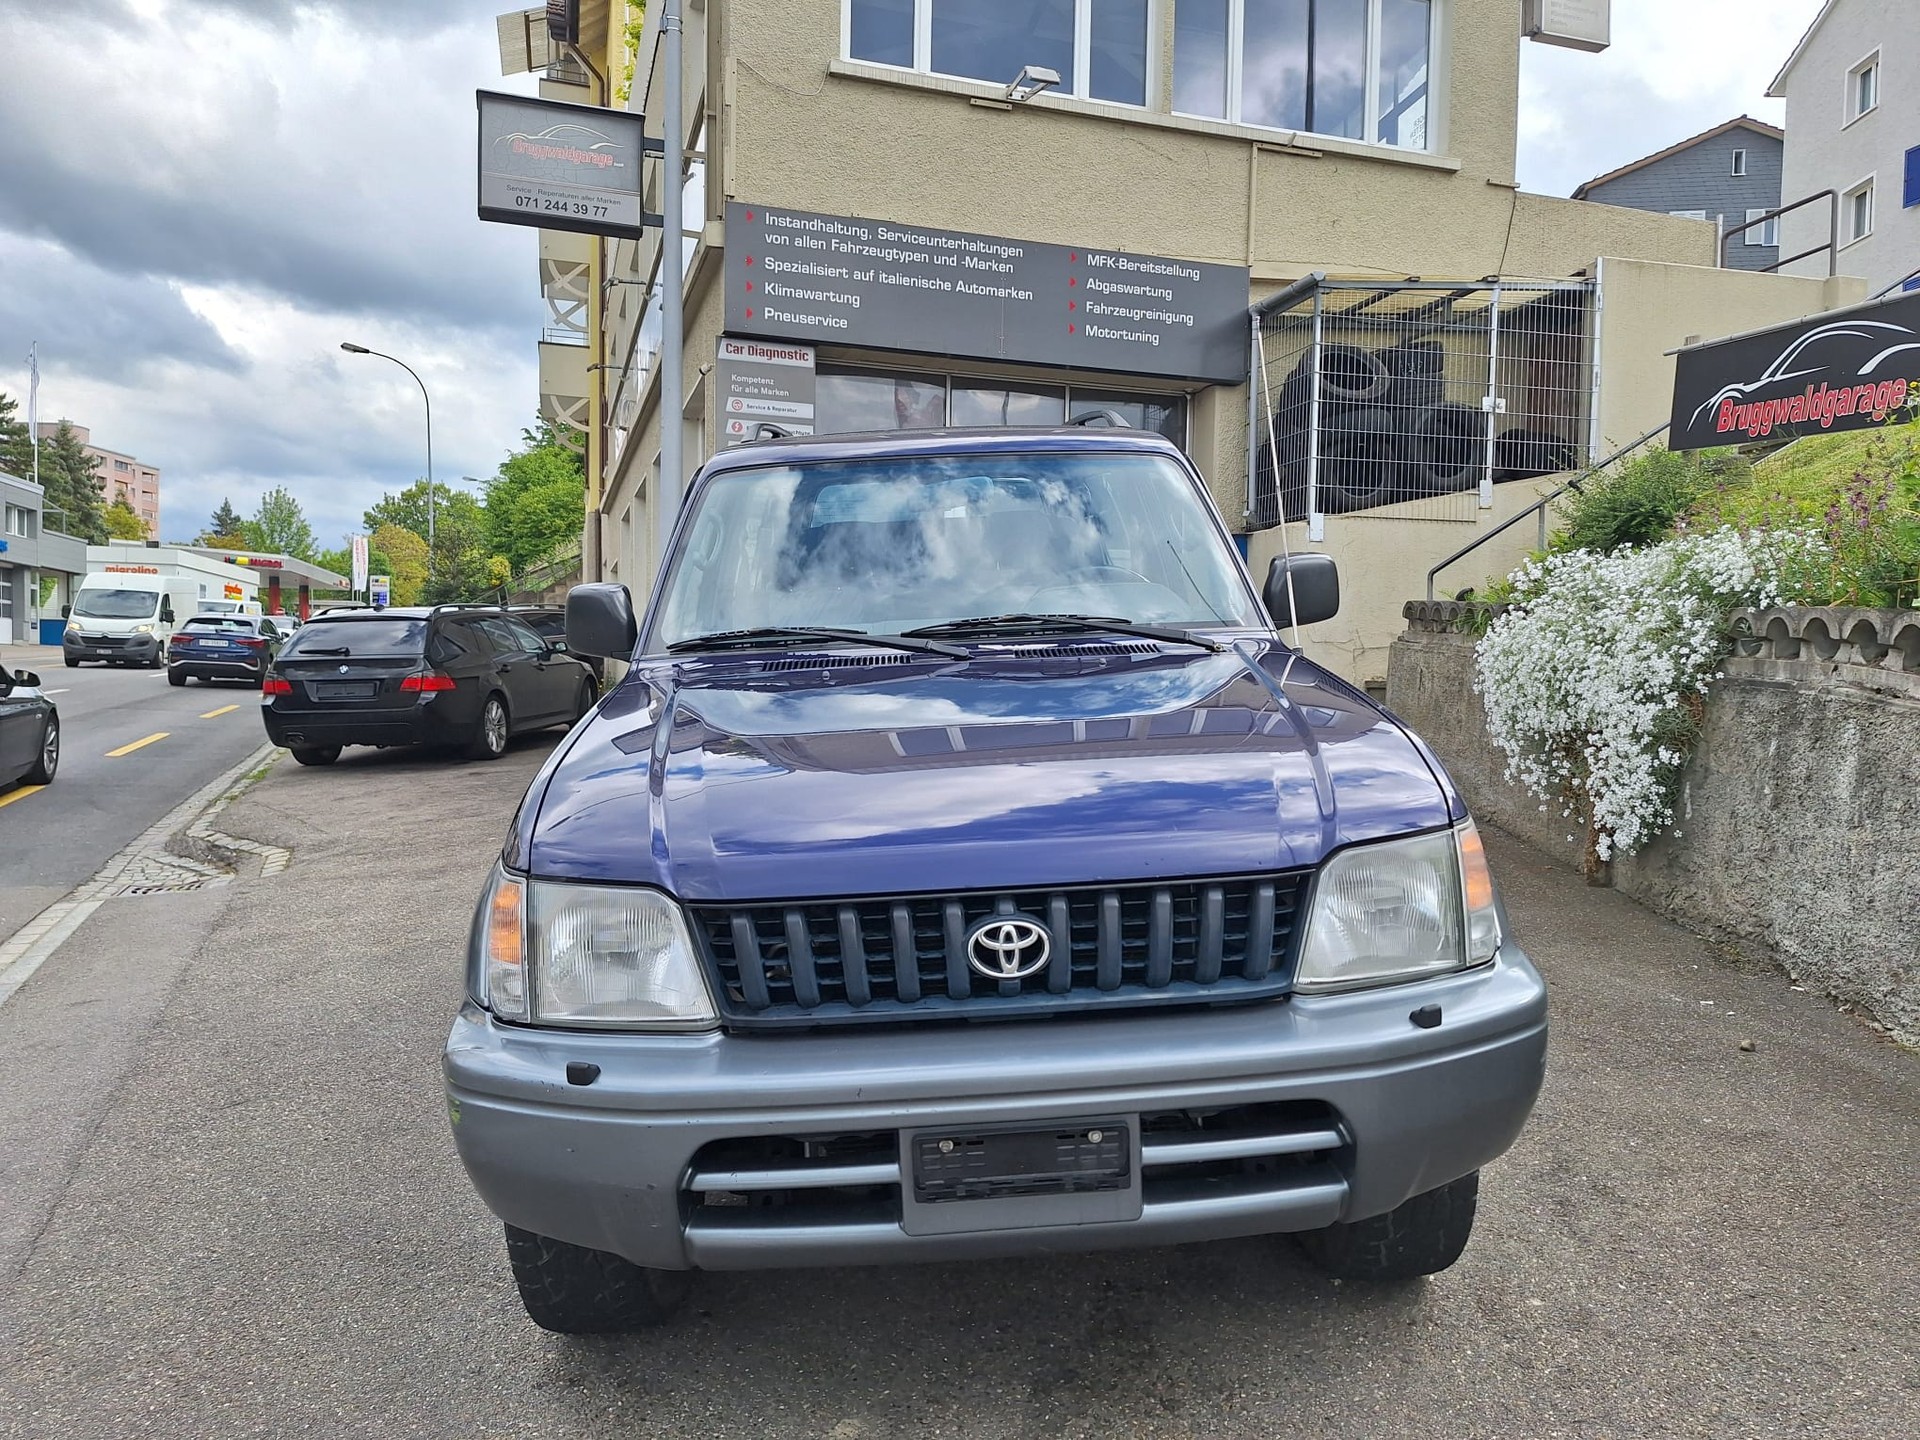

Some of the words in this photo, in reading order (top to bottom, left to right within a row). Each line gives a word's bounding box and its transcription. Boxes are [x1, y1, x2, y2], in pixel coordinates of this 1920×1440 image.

[513, 139, 613, 168] Bruggwaldgarage
[506, 184, 532, 194] Service
[596, 196, 622, 205] Marken
[515, 195, 539, 208] 071
[544, 199, 568, 212] 244
[573, 202, 588, 215] 39
[592, 205, 608, 217] 77
[765, 212, 872, 240] Instandhaltung,
[877, 227, 1024, 258] Serviceunterhaltungen
[764, 233, 790, 246] von
[794, 235, 826, 250] allen
[831, 238, 929, 264] Fahrzeugtypen
[934, 254, 957, 266] und
[961, 256, 1014, 273] -Marken
[764, 256, 849, 278] Spezialisiert
[853, 269, 875, 282] auf
[878, 270, 952, 291] italienische
[955, 280, 1033, 300] Automarken
[1087, 254, 1200, 281] MFK-Bereitstellung
[764, 282, 860, 308] Klimawartung
[1086, 278, 1173, 301] Abgaswartung
[764, 307, 848, 328] Pneuservice
[1086, 301, 1194, 326] Fahrzeugreinigung
[1085, 324, 1160, 346] Motortuning
[725, 342, 745, 355] Car
[747, 345, 809, 362] Diagnostic
[731, 374, 775, 386] Kompetenz
[731, 384, 742, 392] für
[745, 385, 758, 394] alle
[760, 387, 790, 397] Marken
[1716, 378, 1907, 438] Bruggwaldgarage
